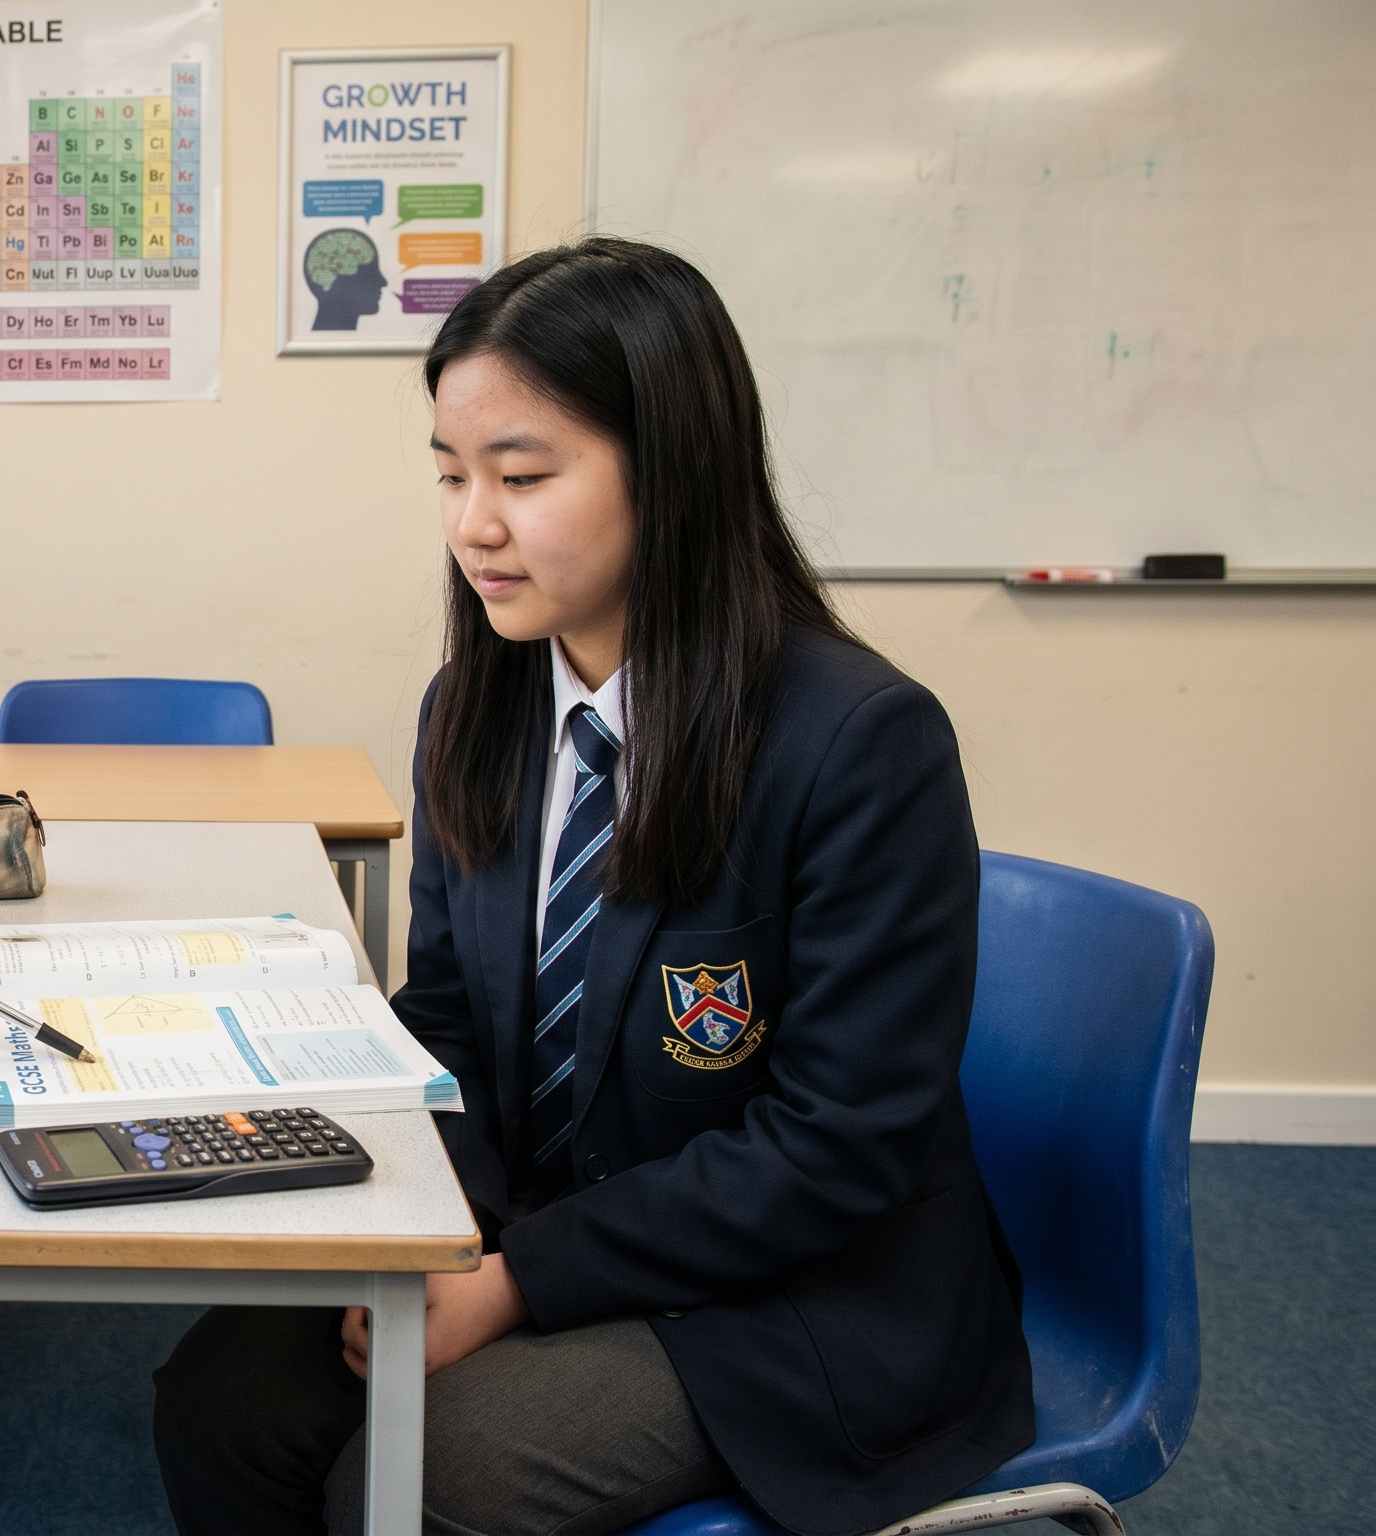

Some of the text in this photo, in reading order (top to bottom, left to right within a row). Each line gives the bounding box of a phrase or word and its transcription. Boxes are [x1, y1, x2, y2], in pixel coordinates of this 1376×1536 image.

[322, 80, 467, 108] GROWTH
[38, 107, 47, 120] B
[67, 106, 76, 119] C
[95, 107, 105, 118] N
[123, 106, 134, 118] O
[153, 104, 161, 117] F
[322, 116, 467, 143] MINDSET
[65, 139, 77, 152] Si
[96, 139, 104, 150] P
[124, 138, 132, 150] S
[178, 139, 193, 150] Ar
[6, 173, 23, 185] Zn
[34, 172, 52, 184] Ga
[63, 172, 81, 184] Ge
[92, 172, 108, 183] As
[120, 170, 136, 183] Se
[150, 170, 164, 182] Br
[178, 170, 193, 182] Kr
[6, 205, 24, 217] Cd
[63, 204, 80, 216] Sn
[91, 203, 109, 215] Sb
[121, 203, 136, 215] Te
[6, 238, 24, 251] Hg
[63, 236, 81, 247] Pb
[120, 235, 137, 246] Po
[176, 235, 195, 245] Rn
[6, 269, 24, 280] Cn
[87, 268, 113, 280] Uup
[173, 267, 198, 278] Uuo
[7, 316, 24, 330] Dy
[35, 316, 53, 327] Ho
[65, 315, 78, 327] Er
[90, 315, 109, 326] Tm
[119, 315, 137, 326] Yb
[148, 315, 164, 326] Lu
[8, 358, 23, 370] Cf
[36, 358, 52, 369] Es
[62, 358, 82, 369] Fm
[90, 357, 109, 368] Md
[119, 358, 137, 368] No
[149, 357, 163, 368] Lr
[15, 1065, 47, 1095] GCSE
